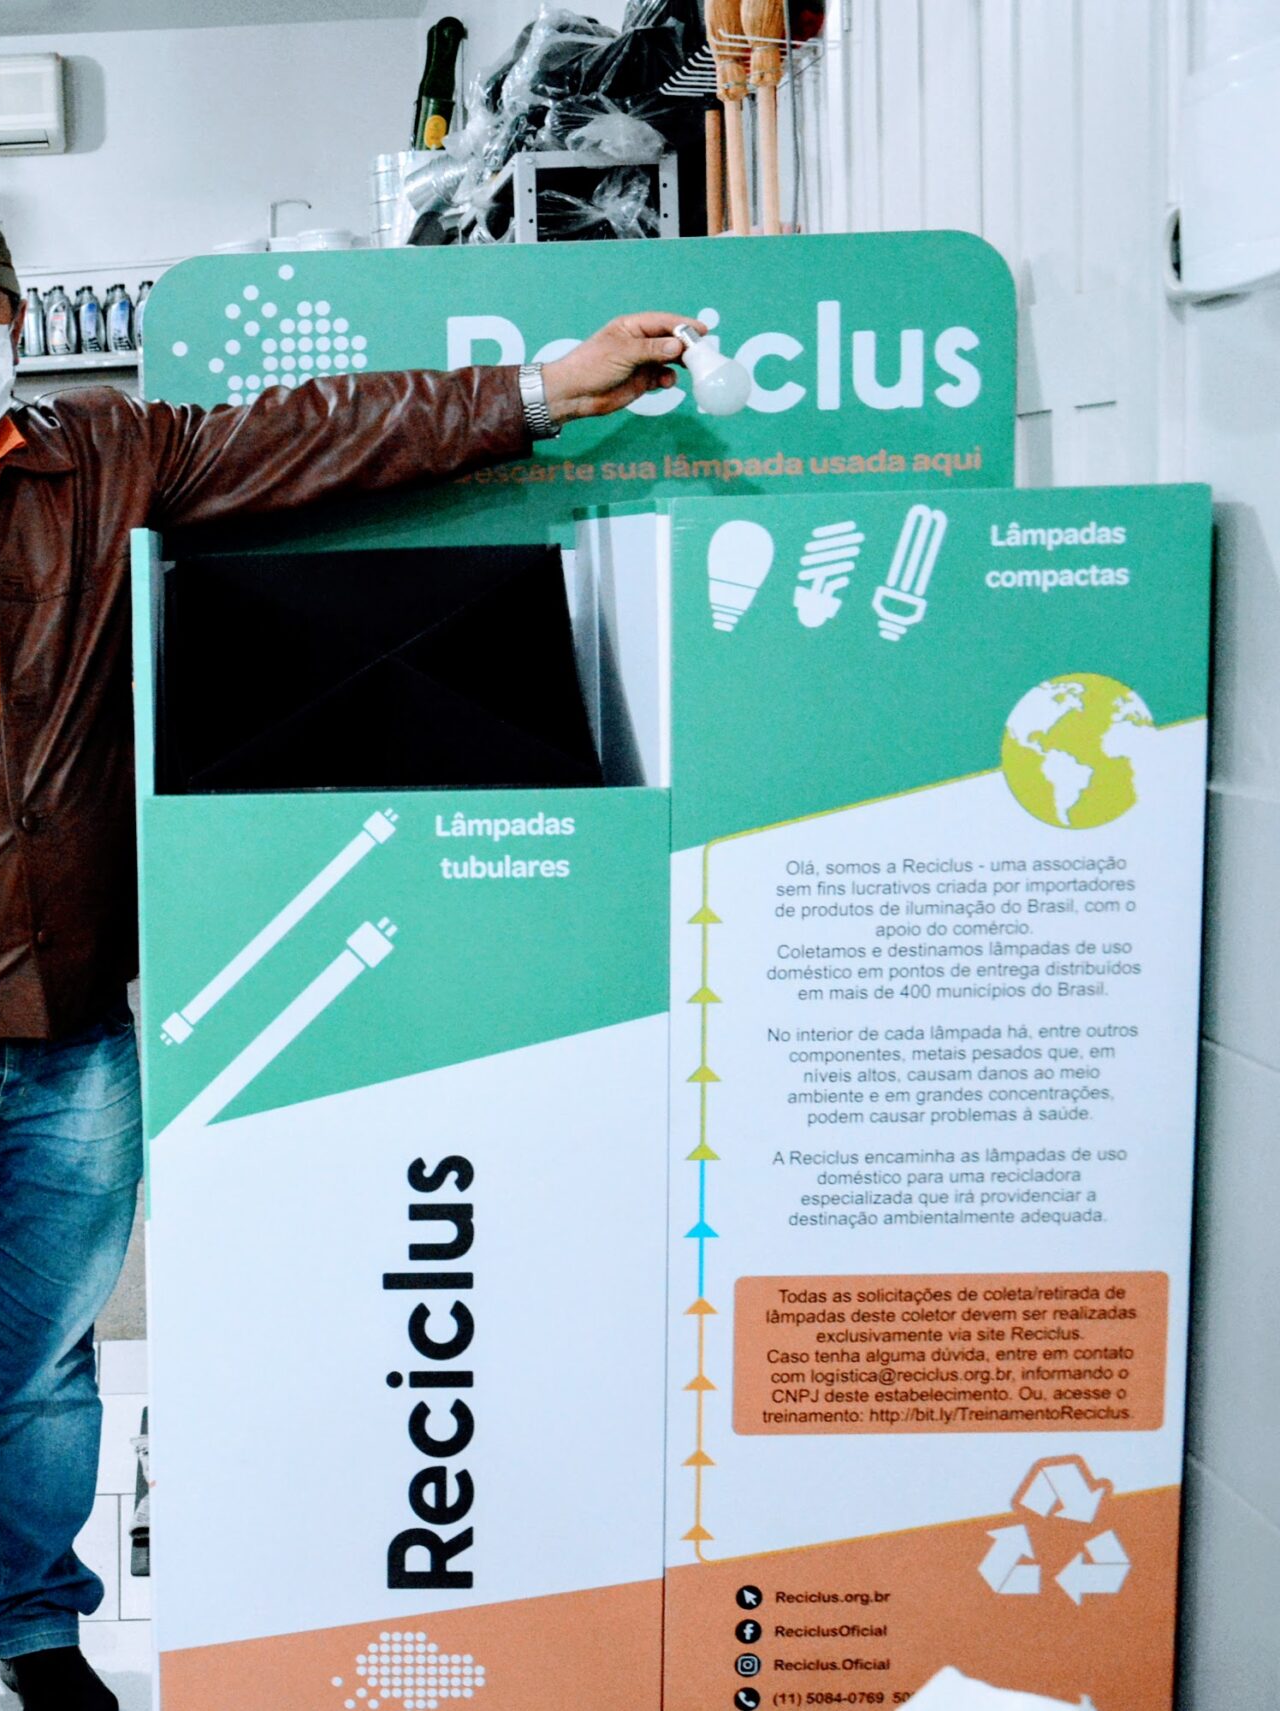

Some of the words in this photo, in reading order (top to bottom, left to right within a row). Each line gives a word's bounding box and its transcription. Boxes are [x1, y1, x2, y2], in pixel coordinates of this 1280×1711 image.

[453, 460, 595, 484] escarte
[600, 460, 656, 481] sua
[663, 453, 804, 481] lâmpada
[809, 449, 906, 475] usada
[912, 445, 982, 477] aqui
[990, 522, 1126, 550] Lâmpadas
[985, 565, 1129, 592] compactas
[435, 812, 575, 842] Lâmpadas
[440, 855, 570, 880] tubulares
[786, 860, 819, 876] Olá,
[826, 862, 881, 874] somos
[887, 863, 896, 873] a
[903, 858, 973, 873] Reciclus
[991, 860, 1026, 872] uma
[1033, 857, 1126, 874] associação
[776, 885, 811, 896] sem
[818, 882, 846, 895] fins
[852, 881, 930, 895] lucrativos
[937, 880, 987, 894] criada
[994, 881, 1020, 895] por
[1026, 879, 1135, 895] importadores
[775, 904, 795, 917] de
[802, 902, 873, 920] produtos
[880, 902, 900, 916] de
[906, 901, 995, 917] iluminação
[1001, 901, 1020, 914] do
[1028, 898, 1078, 913] Brasil,
[1085, 901, 1120, 912] com
[1126, 901, 1136, 912] o
[876, 923, 921, 939] apoio
[927, 922, 947, 936] do
[953, 920, 1033, 935] comércio.
[777, 944, 866, 959] Coletamos
[872, 946, 882, 958] e
[888, 944, 983, 957] destinamos
[990, 941, 1070, 958] lâmpadas
[1076, 941, 1096, 954] de
[1102, 943, 1132, 953] uso
[767, 965, 852, 980] doméstico
[858, 968, 883, 979] em
[889, 966, 944, 981] pontos
[951, 964, 971, 977] de
[977, 965, 1039, 979] entrega
[1045, 962, 1141, 975] distribuídos
[798, 989, 823, 1000] em
[830, 986, 868, 1000] mais
[874, 985, 894, 999] de
[900, 984, 930, 998] 400
[937, 984, 1025, 1000] municípios
[1031, 983, 1052, 996] do
[1058, 982, 1108, 996] Brasil.
[768, 1029, 790, 1042] No
[797, 1028, 853, 1041] interior
[859, 1027, 878, 1041] de
[885, 1027, 924, 1040] cada
[930, 1025, 1001, 1042] lâmpada
[1007, 1025, 1032, 1039] há,
[1038, 1025, 1081, 1038] entre
[1086, 1025, 1138, 1037] outros
[789, 1049, 905, 1064] componentes,
[912, 1047, 966, 1061] metais
[972, 1046, 1042, 1062] pesados
[1048, 1047, 1083, 1061] que,
[1090, 1047, 1115, 1058] em
[804, 1069, 851, 1083] níveis
[857, 1068, 900, 1082] altos,
[907, 1069, 972, 1081] causam
[978, 1067, 1028, 1080] danos
[1034, 1068, 1054, 1079] ao
[1060, 1067, 1100, 1079] meio
[787, 1090, 864, 1103] ambiente
[870, 1091, 879, 1102] e
[885, 1091, 910, 1102] em
[916, 1088, 983, 1105] grandes
[989, 1086, 1114, 1102] concentrações,
[807, 1110, 864, 1127] podem
[870, 1111, 925, 1123] causar
[930, 1108, 1017, 1125] problemas
[1023, 1108, 1032, 1120] à
[1039, 1107, 1092, 1120] saúde.
[772, 1152, 784, 1165] A
[790, 1151, 859, 1165] Reciclus
[865, 1149, 954, 1163] encaminha
[961, 1151, 980, 1162] as
[986, 1148, 1065, 1164] lâmpadas
[1072, 1147, 1091, 1161] de
[1098, 1150, 1127, 1160] uso
[817, 1170, 901, 1185] doméstico
[907, 1172, 943, 1186] para
[950, 1172, 984, 1183] uma
[991, 1169, 1081, 1182] recicladora
[801, 1191, 913, 1207] especializada
[918, 1192, 949, 1207] que
[955, 1190, 975, 1203] irá
[980, 1189, 1082, 1206] providenciar
[1086, 1190, 1096, 1201] a
[789, 1212, 878, 1228] destinação
[884, 1210, 1014, 1225] ambientalmente
[1021, 1209, 1106, 1225] adequada.
[779, 1289, 827, 1303] Todas
[833, 1292, 851, 1303] as
[857, 1288, 952, 1305] solicitações
[957, 1287, 977, 1301] de
[983, 1286, 1100, 1301] coleta/retirada
[1105, 1286, 1125, 1300] de
[766, 1310, 845, 1326] lâmpadas
[851, 1309, 895, 1323] deste
[901, 1308, 956, 1321] coletor
[962, 1308, 1017, 1321] devem
[1023, 1309, 1048, 1320] ser
[1053, 1307, 1136, 1319] realizadas
[816, 1329, 943, 1343] exclusivamente
[949, 1328, 971, 1341] via
[977, 1327, 1005, 1341] site
[1011, 1326, 1084, 1340] Reciclus.
[767, 1349, 809, 1364] Caso
[815, 1348, 860, 1362] tenha
[866, 1348, 925, 1365] alguma
[931, 1348, 989, 1363] dúvida,
[996, 1348, 1037, 1361] entre
[1043, 1348, 1068, 1360] em
[1074, 1347, 1134, 1360] contato
[382, 1155, 474, 1589] Reciclus
[771, 1371, 805, 1384] com
[1022, 1366, 1113, 1380] informando
[1118, 1368, 1129, 1379] o
[772, 1388, 819, 1403] CNPJ
[825, 1389, 869, 1402] deste
[875, 1387, 1012, 1402] estabelecimento.
[1019, 1386, 1047, 1401] Ou,
[1053, 1388, 1111, 1400] acesse
[1117, 1388, 1126, 1399] o
[763, 1409, 863, 1423] treinamento:
[775, 1590, 890, 1605] Reciclus.org.br
[775, 1625, 887, 1638] ReciclusOficial
[773, 1692, 801, 1707] (11)
[807, 1692, 884, 1704] 5084-0769
